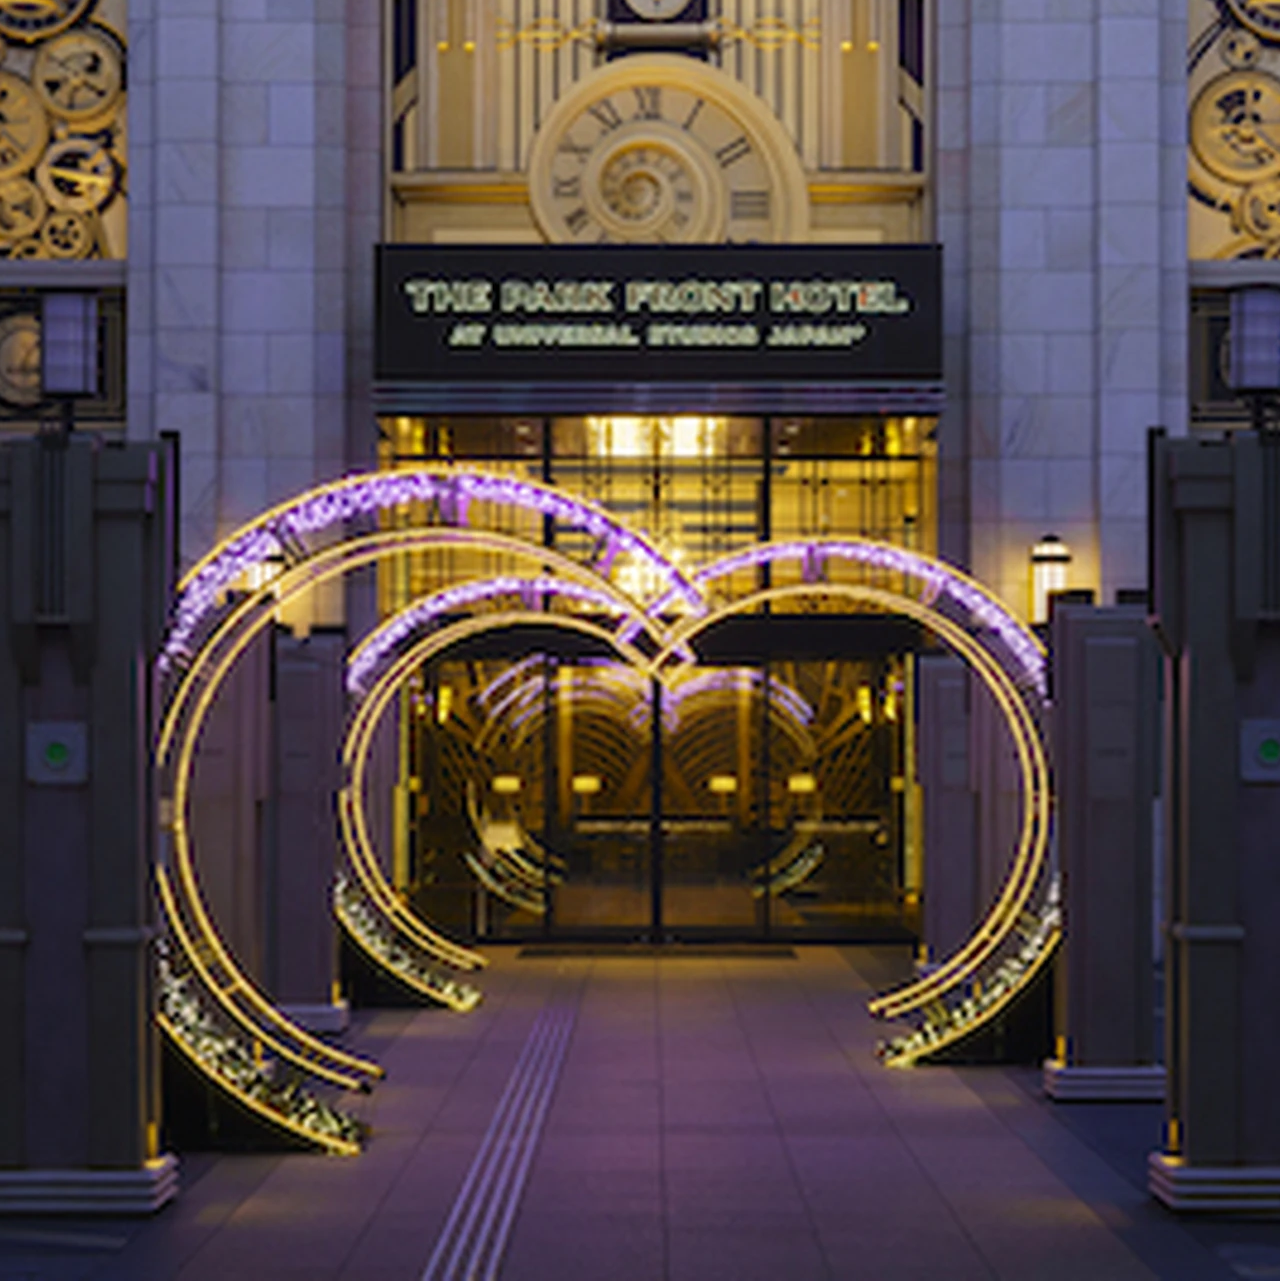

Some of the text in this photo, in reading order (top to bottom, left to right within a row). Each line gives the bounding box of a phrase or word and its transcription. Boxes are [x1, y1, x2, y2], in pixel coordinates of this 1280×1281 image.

[405, 280, 909, 313] THE PARK FRONT HOTEL
[449, 324, 487, 346] AT
